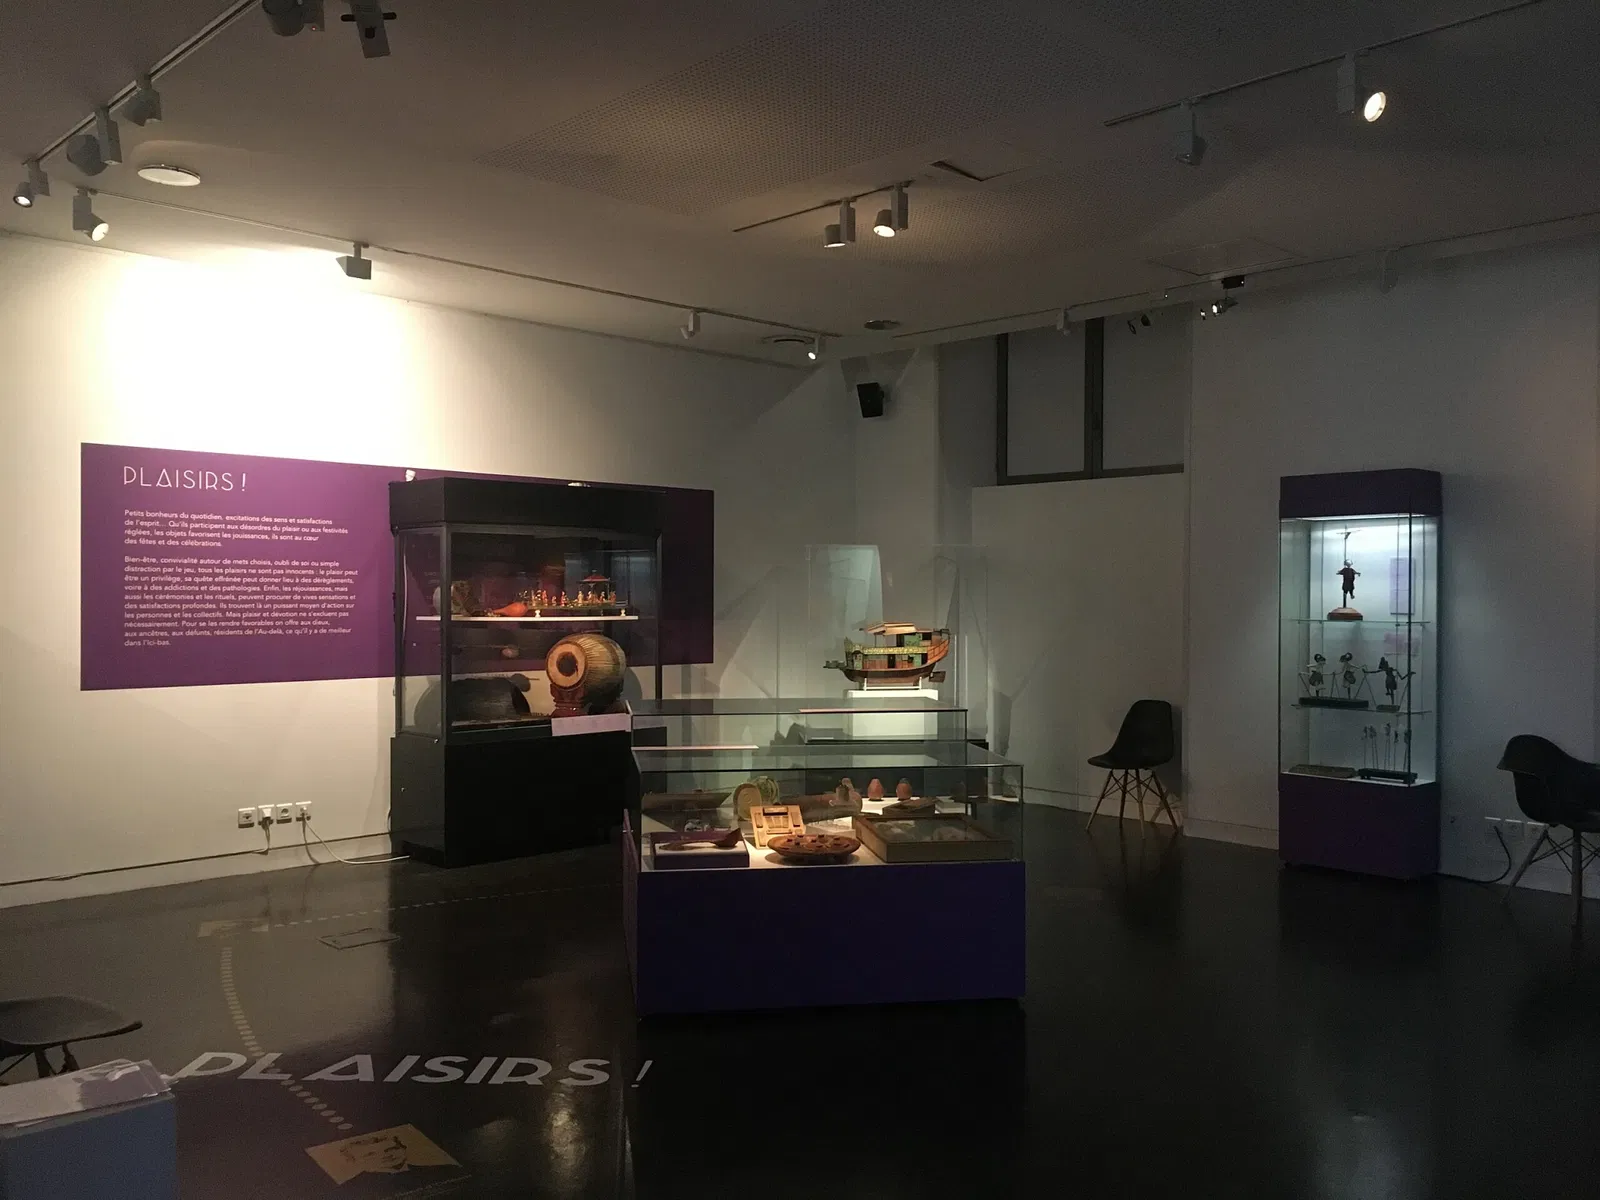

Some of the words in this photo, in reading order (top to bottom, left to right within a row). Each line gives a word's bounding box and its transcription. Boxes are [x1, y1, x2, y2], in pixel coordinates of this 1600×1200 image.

[123, 466, 234, 492] PLAISIRS
[241, 473, 247, 492] !
[124, 509, 144, 518] Petits
[146, 510, 178, 519] bonheurs
[179, 511, 188, 519] du
[225, 513, 259, 522] excitations
[260, 514, 272, 522] des
[288, 515, 295, 523] et
[296, 516, 332, 525] satisfactions
[124, 518, 133, 526] de
[168, 520, 188, 528] Qu'ils
[189, 521, 225, 532] participent
[239, 522, 271, 531] désordres
[272, 524, 280, 532] du
[282, 524, 299, 534] plaisir
[322, 525, 348, 534] festivités
[124, 528, 152, 538] réglées,
[154, 528, 164, 537] les
[165, 529, 186, 539] objets
[188, 530, 220, 538] favorisent
[222, 531, 231, 539] les
[232, 531, 269, 542] jouissances,
[280, 532, 293, 541] sont
[124, 537, 137, 545] des
[139, 537, 156, 546] fêtes
[158, 538, 165, 546] et
[166, 538, 179, 546] des
[124, 555, 158, 564] Bien-être,
[160, 556, 197, 564] convivialité
[199, 557, 220, 565] autour
[222, 557, 231, 565] de
[232, 557, 248, 565] mets
[250, 558, 272, 566] choisis,
[274, 558, 289, 566] oubli
[291, 558, 299, 566] de
[300, 558, 309, 566] soi
[320, 559, 339, 569] simple
[124, 565, 161, 573] distraction
[162, 567, 173, 575] par
[175, 565, 182, 573] le
[184, 566, 196, 576] jeu,
[198, 566, 212, 574] tous
[214, 566, 223, 574] les
[224, 566, 246, 576] plaisirs
[258, 566, 271, 575] sont
[272, 569, 284, 577] pas
[285, 567, 314, 575] innocents
[319, 567, 324, 575] le
[326, 568, 343, 578] plaisir
[344, 568, 358, 578] peut
[124, 574, 138, 582] être
[193, 574, 213, 585] quête
[214, 575, 241, 583] effrénée
[242, 575, 257, 585] peut
[258, 575, 281, 583] donner
[282, 575, 294, 583] lieu
[300, 576, 311, 584] des
[124, 583, 141, 591] voire
[144, 583, 148, 591] à
[150, 583, 162, 591] des
[164, 583, 198, 591] addictions
[208, 584, 220, 592] des
[282, 584, 291, 592] les
[334, 584, 347, 592] mais
[154, 592, 194, 600] cérémonies
[238, 592, 264, 602] peuvent
[272, 601, 298, 611] puissant
[136, 613, 171, 621] personnes
[182, 610, 191, 618] les
[193, 610, 222, 618] collectifs.
[226, 610, 240, 618] Mais
[242, 610, 261, 620] plaisir
[262, 610, 269, 618] et
[270, 610, 297, 618] dévotion
[308, 610, 337, 618] s'excluent
[338, 612, 348, 620] pas
[124, 619, 179, 628] nécessairement.
[181, 619, 197, 627] Pour
[208, 619, 217, 627] les
[218, 619, 240, 627] rendre
[241, 619, 273, 627] favorables
[284, 618, 298, 626] offre
[138, 629, 169, 638] ancêtres,
[214, 628, 243, 636] résidents
[244, 628, 253, 636] de
[294, 627, 307, 637] qu'il
[308, 629, 312, 637] y
[318, 626, 327, 634] de
[328, 626, 351, 634] meilleur
[172, 1051, 610, 1087] PLAISIRS
[631, 1060, 653, 1088] !
